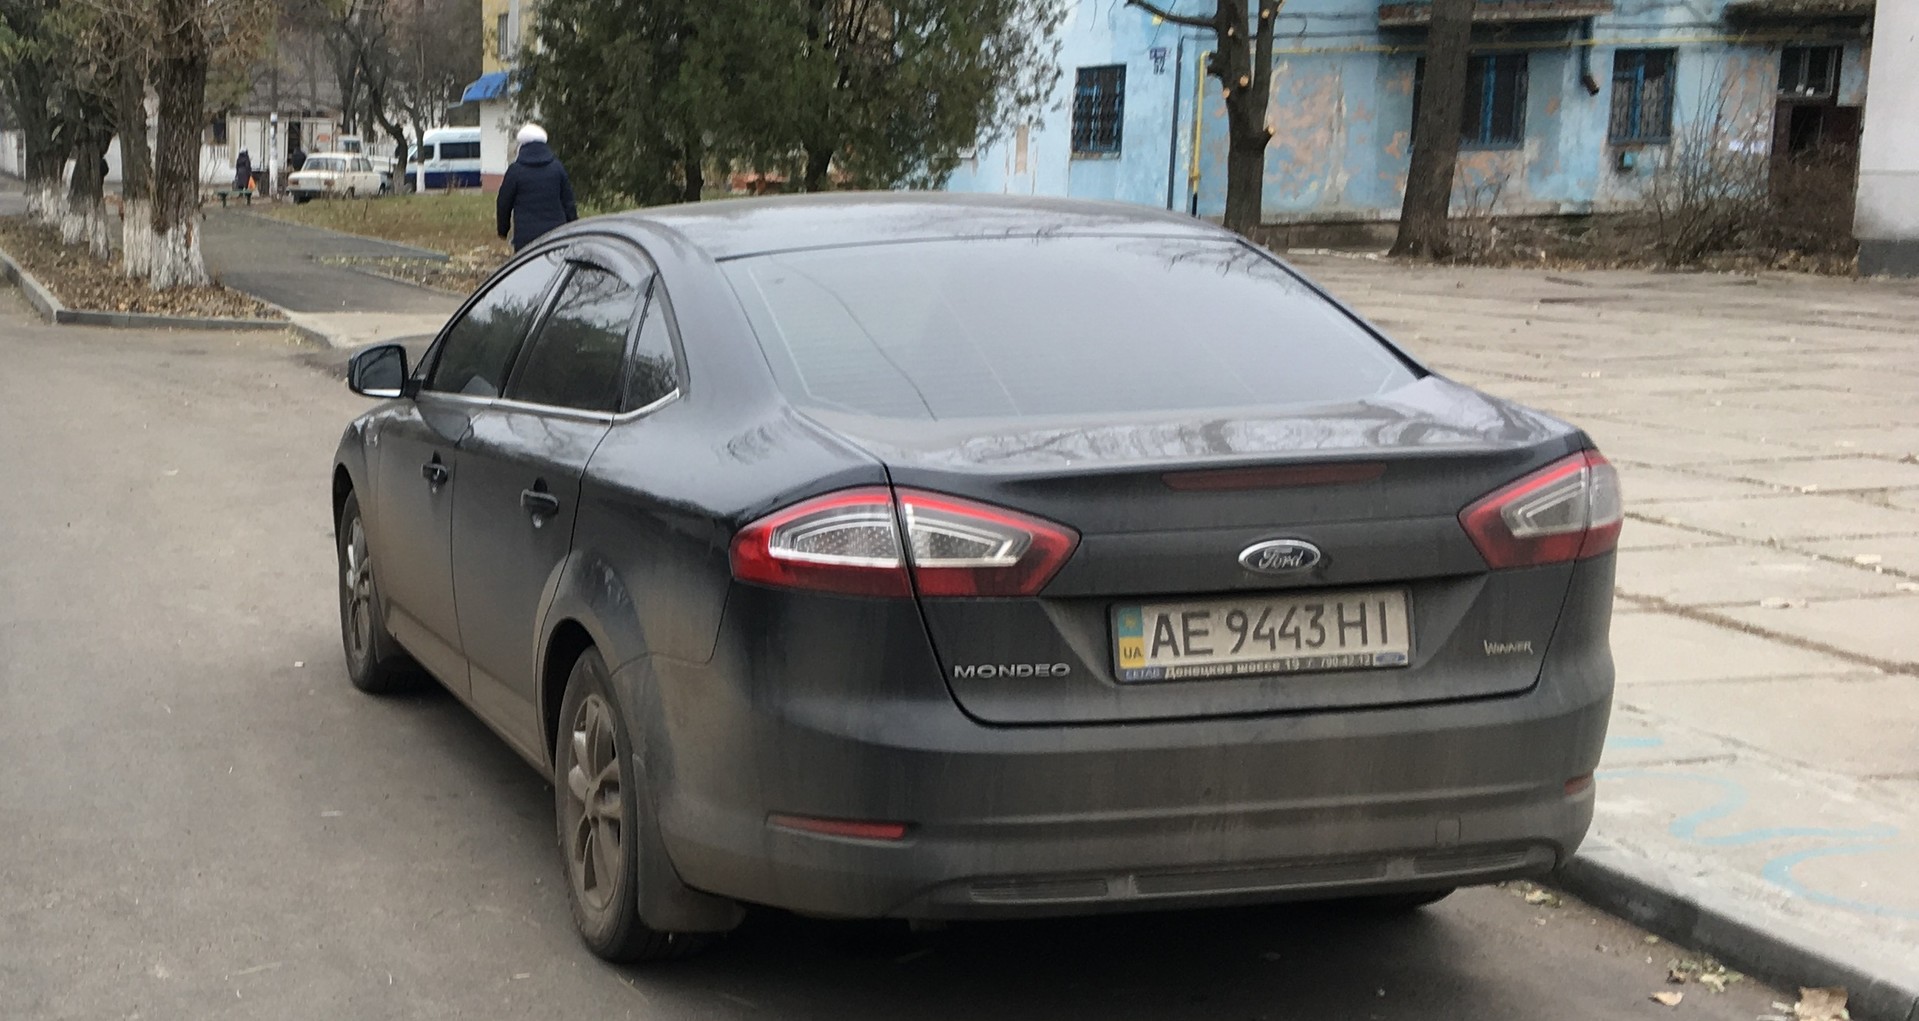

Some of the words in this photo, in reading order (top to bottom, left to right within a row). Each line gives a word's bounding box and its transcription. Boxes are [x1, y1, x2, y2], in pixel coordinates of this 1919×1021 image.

[1258, 546, 1304, 569] Ford
[1150, 610, 1214, 659] AE
[1225, 603, 1327, 655] 9443
[1123, 645, 1143, 659] UA
[954, 662, 1071, 678] MONDEO
